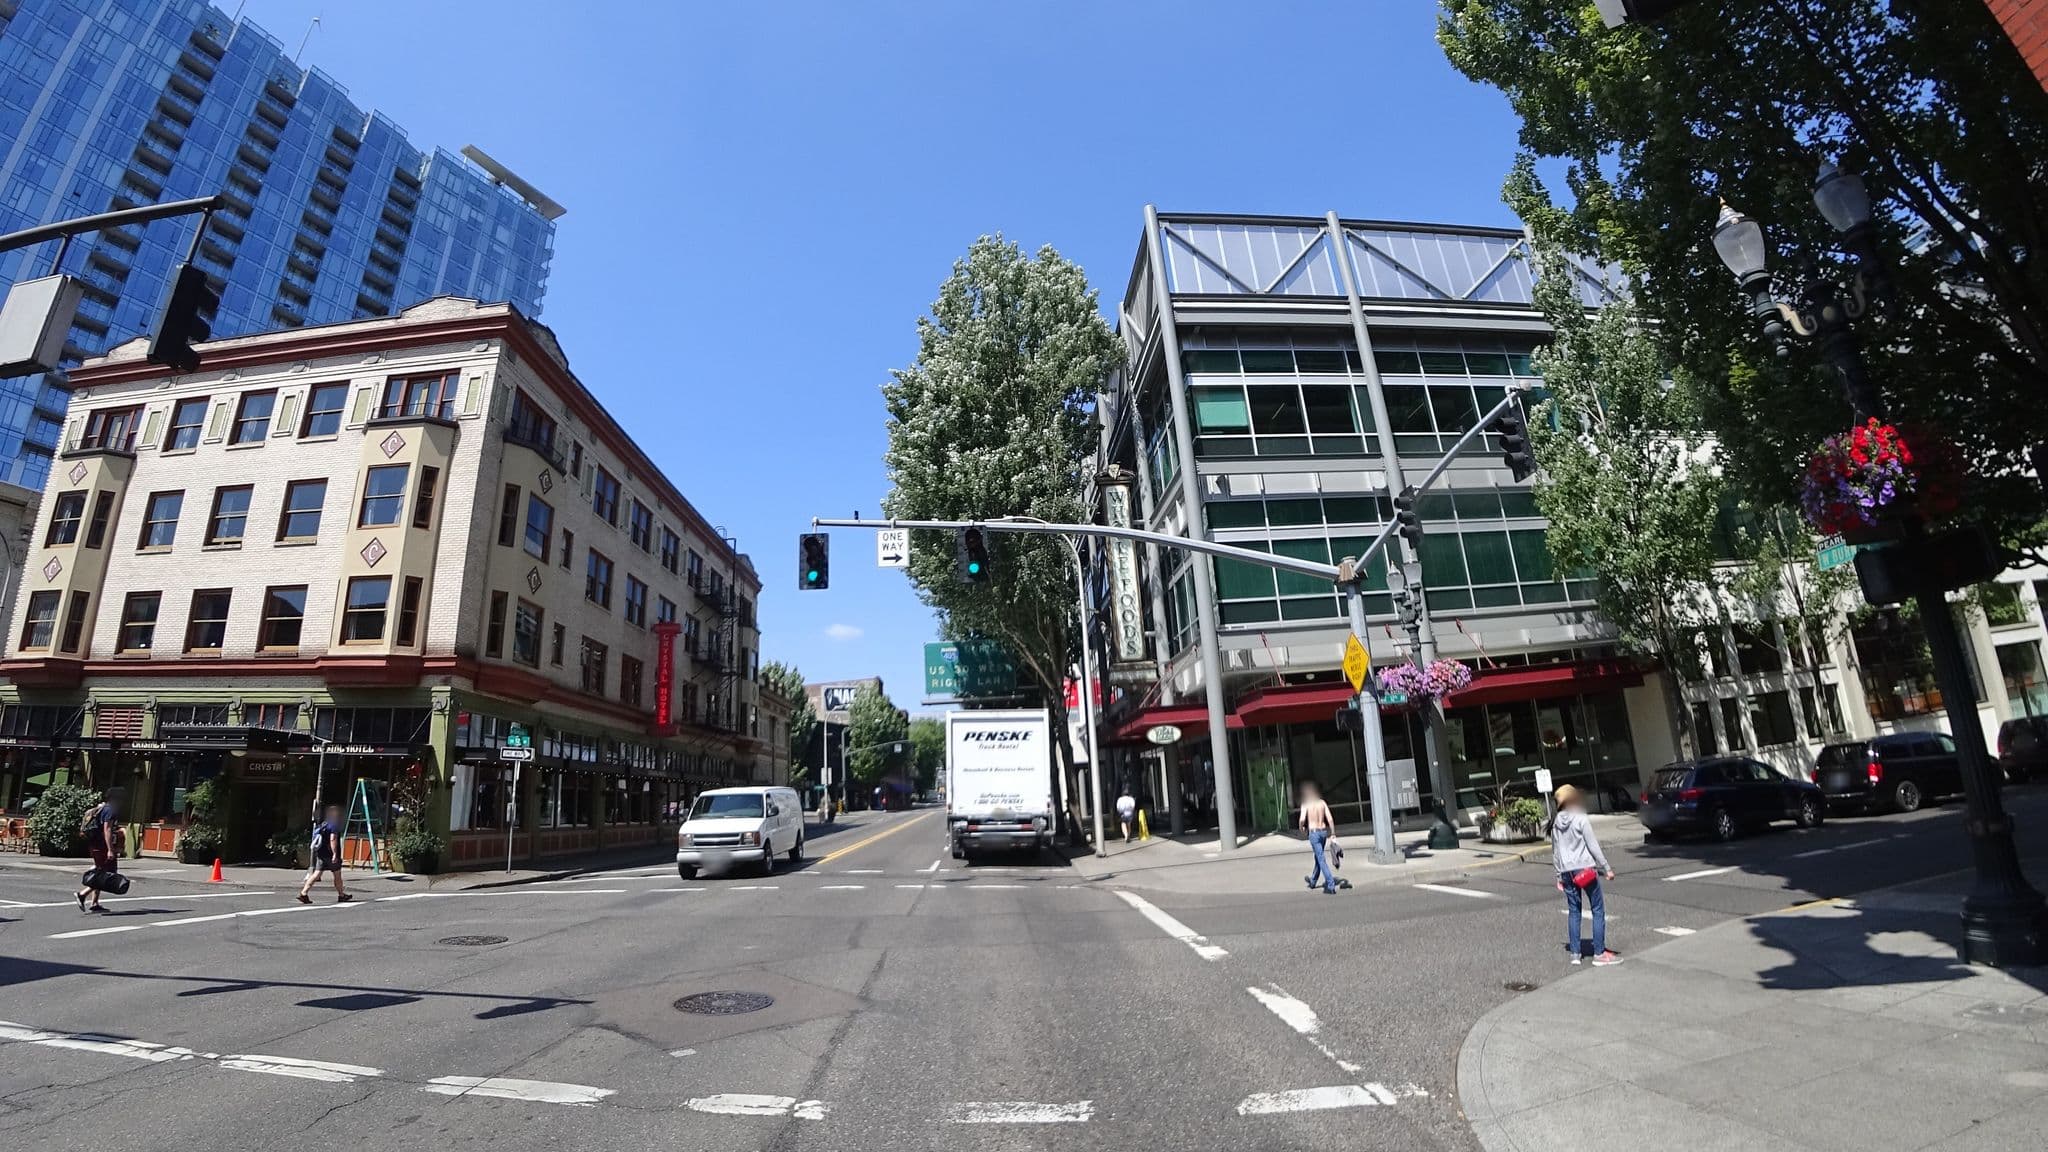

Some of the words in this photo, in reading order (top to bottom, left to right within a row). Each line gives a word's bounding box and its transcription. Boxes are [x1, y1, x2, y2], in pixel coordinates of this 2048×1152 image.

[883, 532, 904, 541] ONE
[882, 542, 904, 551] WAY
[1818, 535, 1844, 551] PEARL
[1120, 577, 1137, 657] FOODS
[662, 633, 670, 682] CRYSTAL
[929, 666, 945, 675] US
[659, 687, 668, 724] HOTEL
[963, 730, 1034, 742] PENSKE
[346, 745, 375, 754] HOTEL
